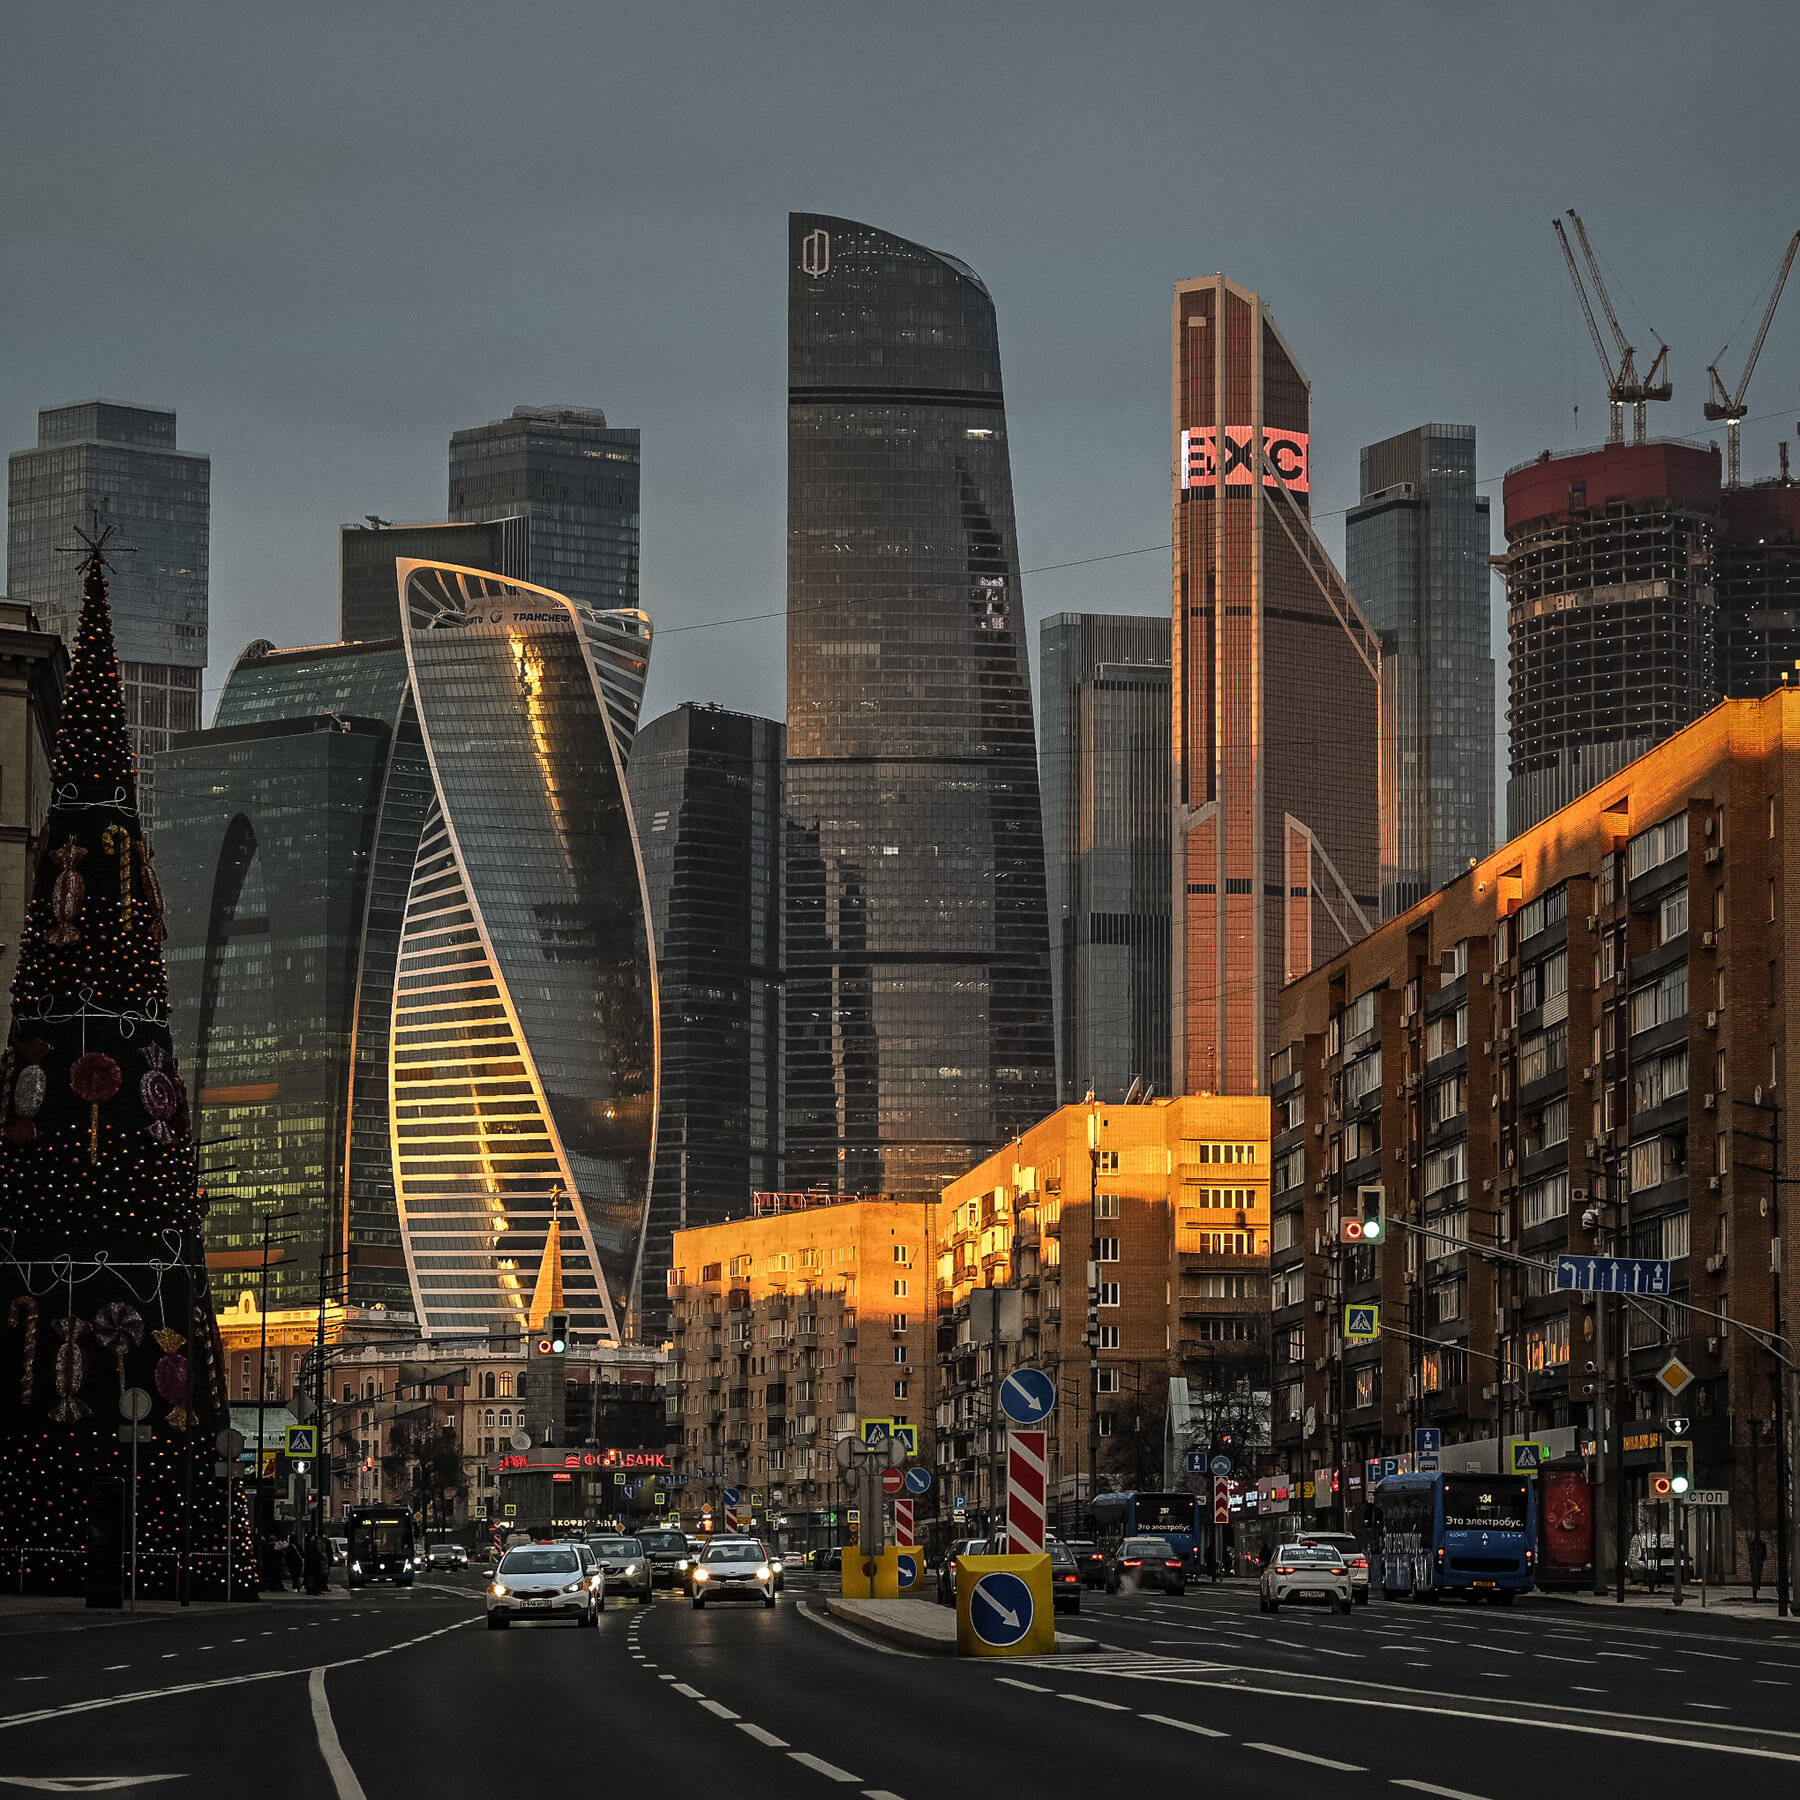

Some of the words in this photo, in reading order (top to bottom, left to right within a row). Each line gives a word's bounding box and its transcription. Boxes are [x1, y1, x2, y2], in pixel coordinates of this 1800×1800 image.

[1188, 436, 1309, 482] EXC
[1372, 1465, 1381, 1479] P
[1385, 1461, 1396, 1475] P
[957, 1497, 964, 1508] P
[1689, 1491, 1723, 1503] СТОП
[1137, 1523, 1151, 1531] Это
[1445, 1516, 1463, 1526] Это
[1465, 1516, 1524, 1528] электробус.
